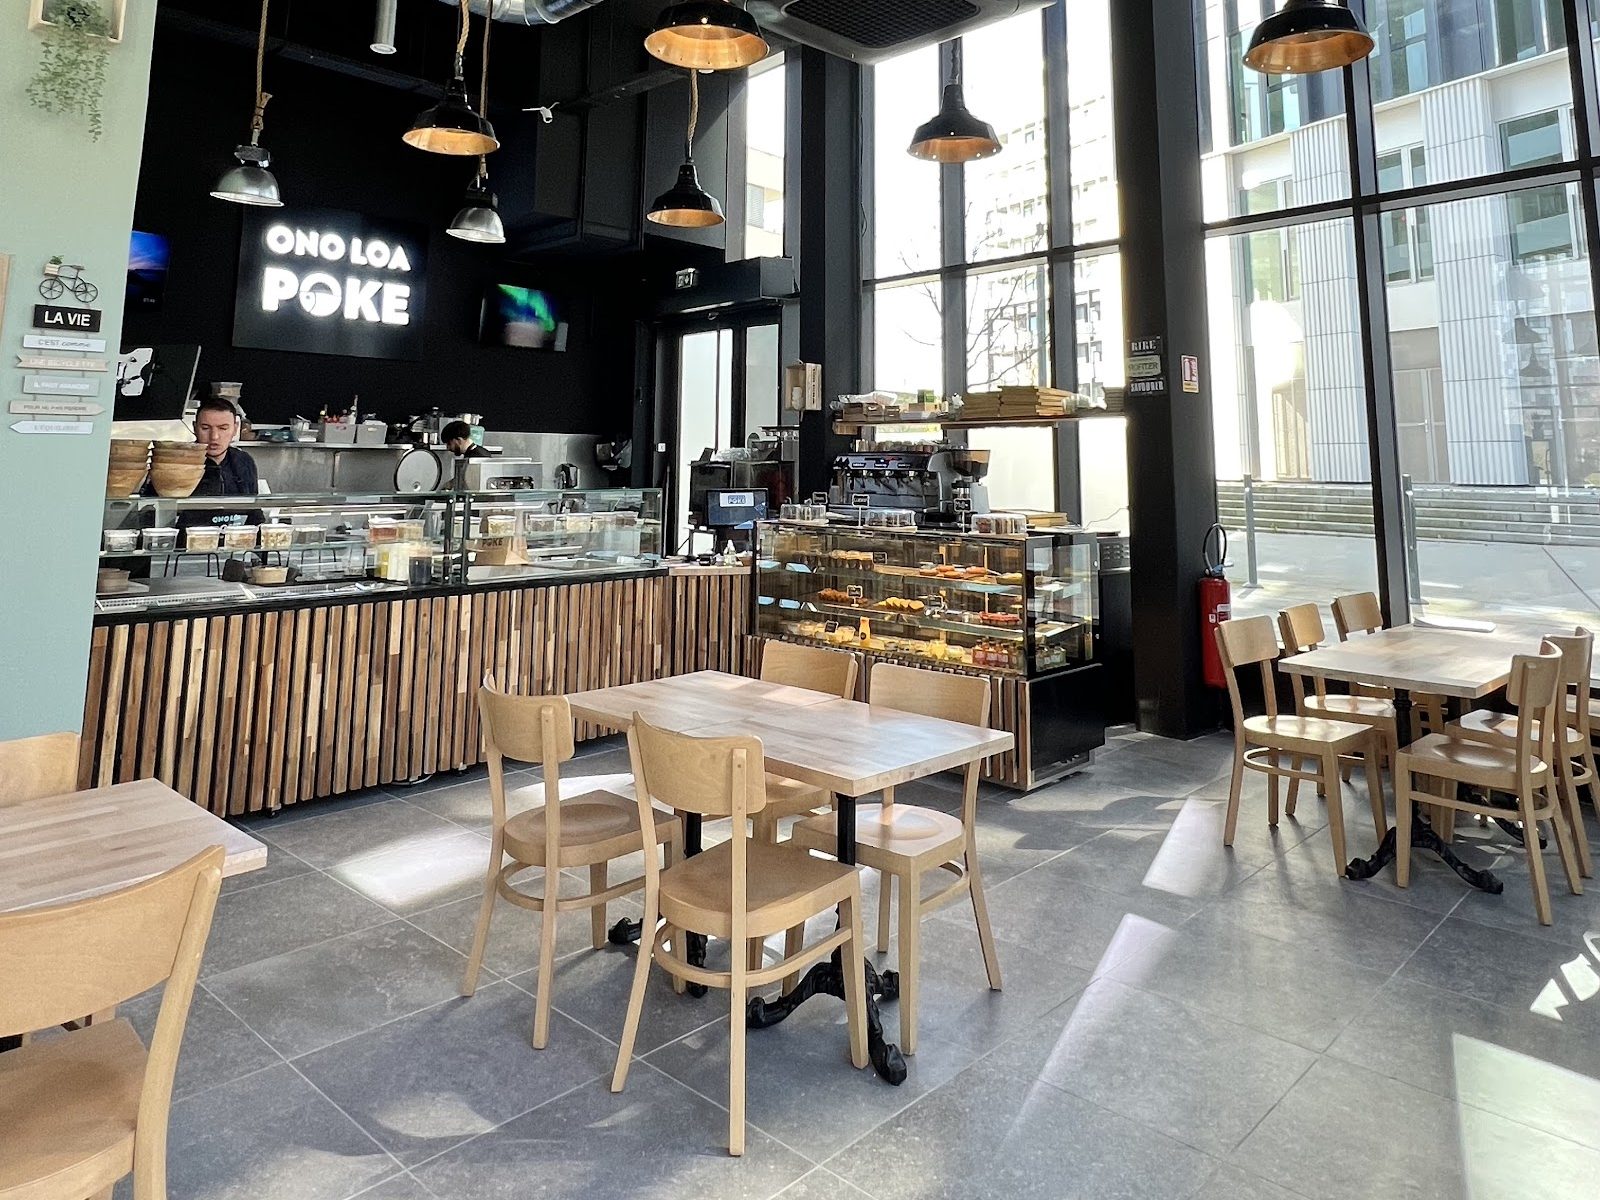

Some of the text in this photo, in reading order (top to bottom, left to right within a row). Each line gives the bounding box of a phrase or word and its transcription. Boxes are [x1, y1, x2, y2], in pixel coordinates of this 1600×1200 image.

[266, 225, 411, 271] ONO LOA
[44, 310, 91, 327] LA VIE
[262, 267, 410, 325] POKE
